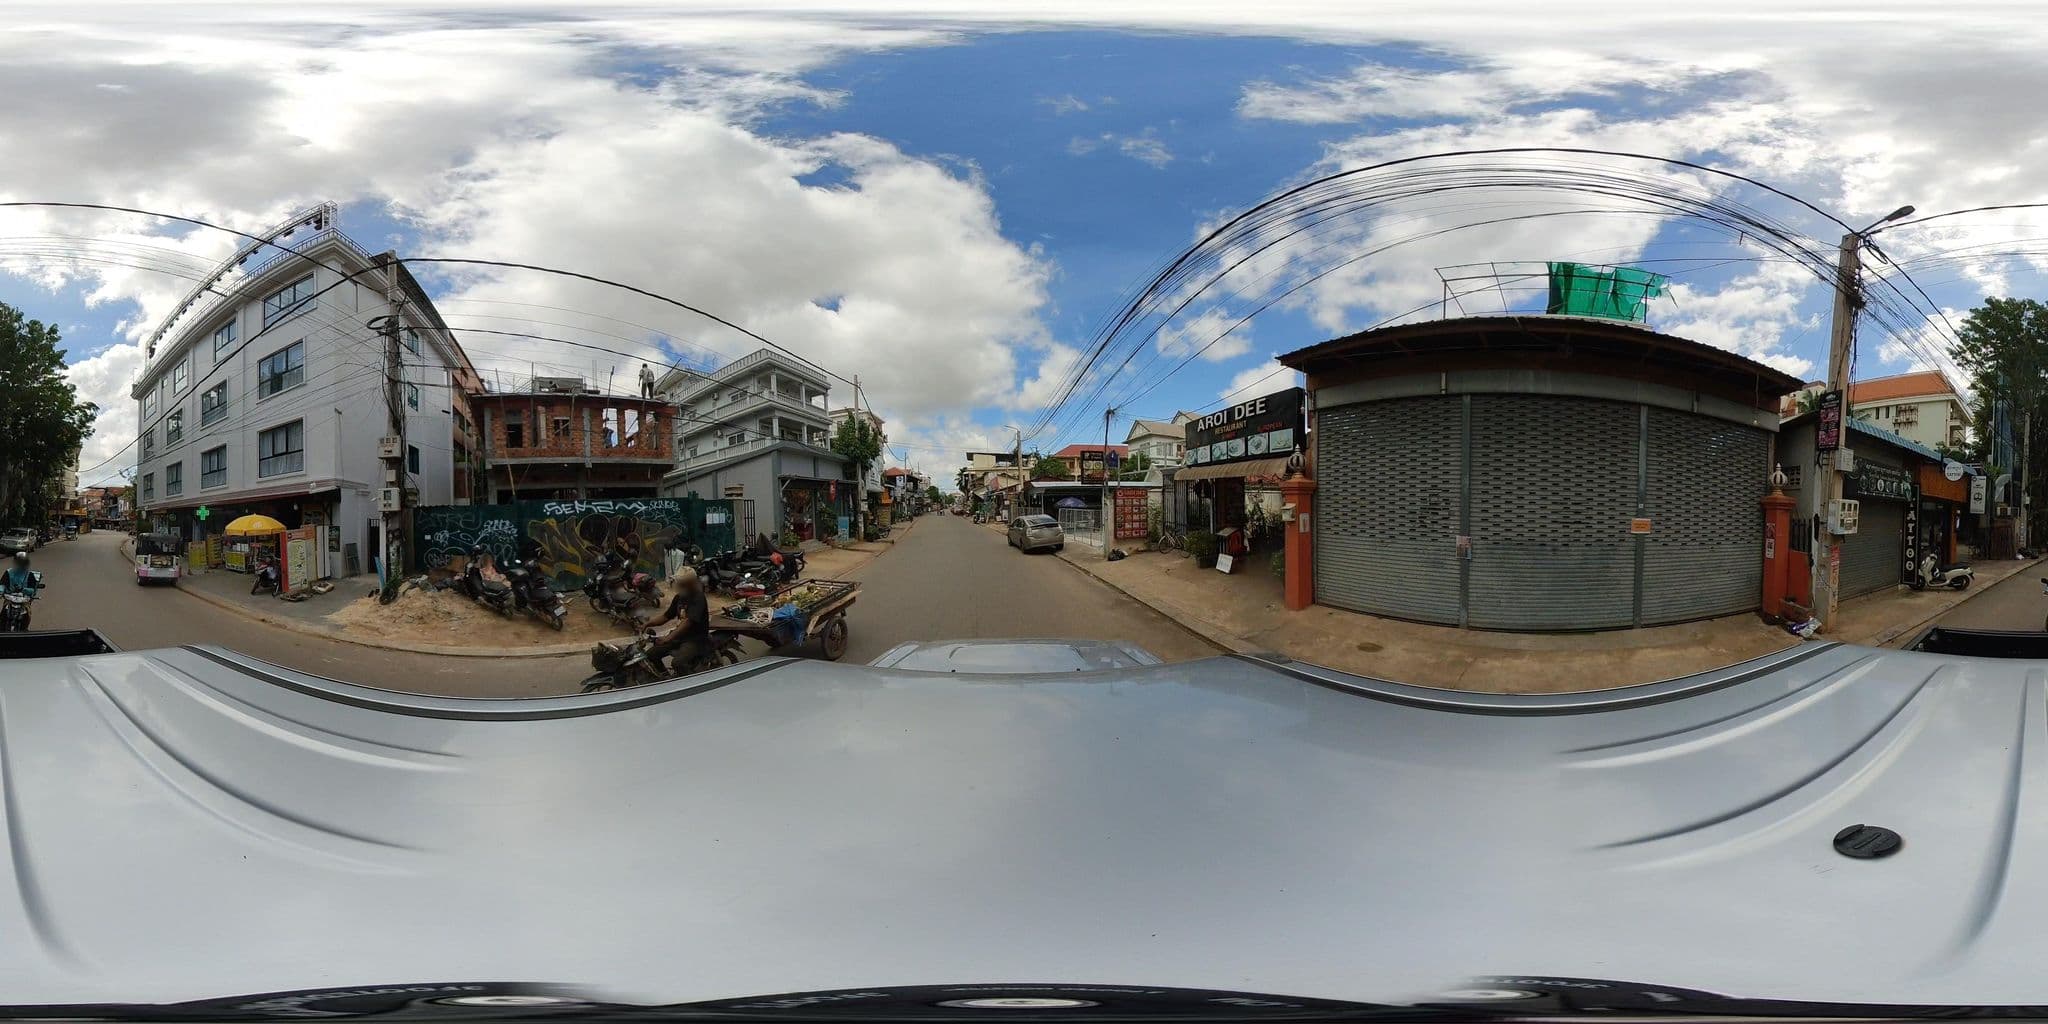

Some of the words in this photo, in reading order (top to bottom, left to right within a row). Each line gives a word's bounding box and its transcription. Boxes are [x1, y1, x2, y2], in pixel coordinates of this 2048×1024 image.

[1197, 411, 1228, 432] AROI
[1235, 398, 1267, 419] DEE
[1214, 420, 1248, 435] RESTAURANT
